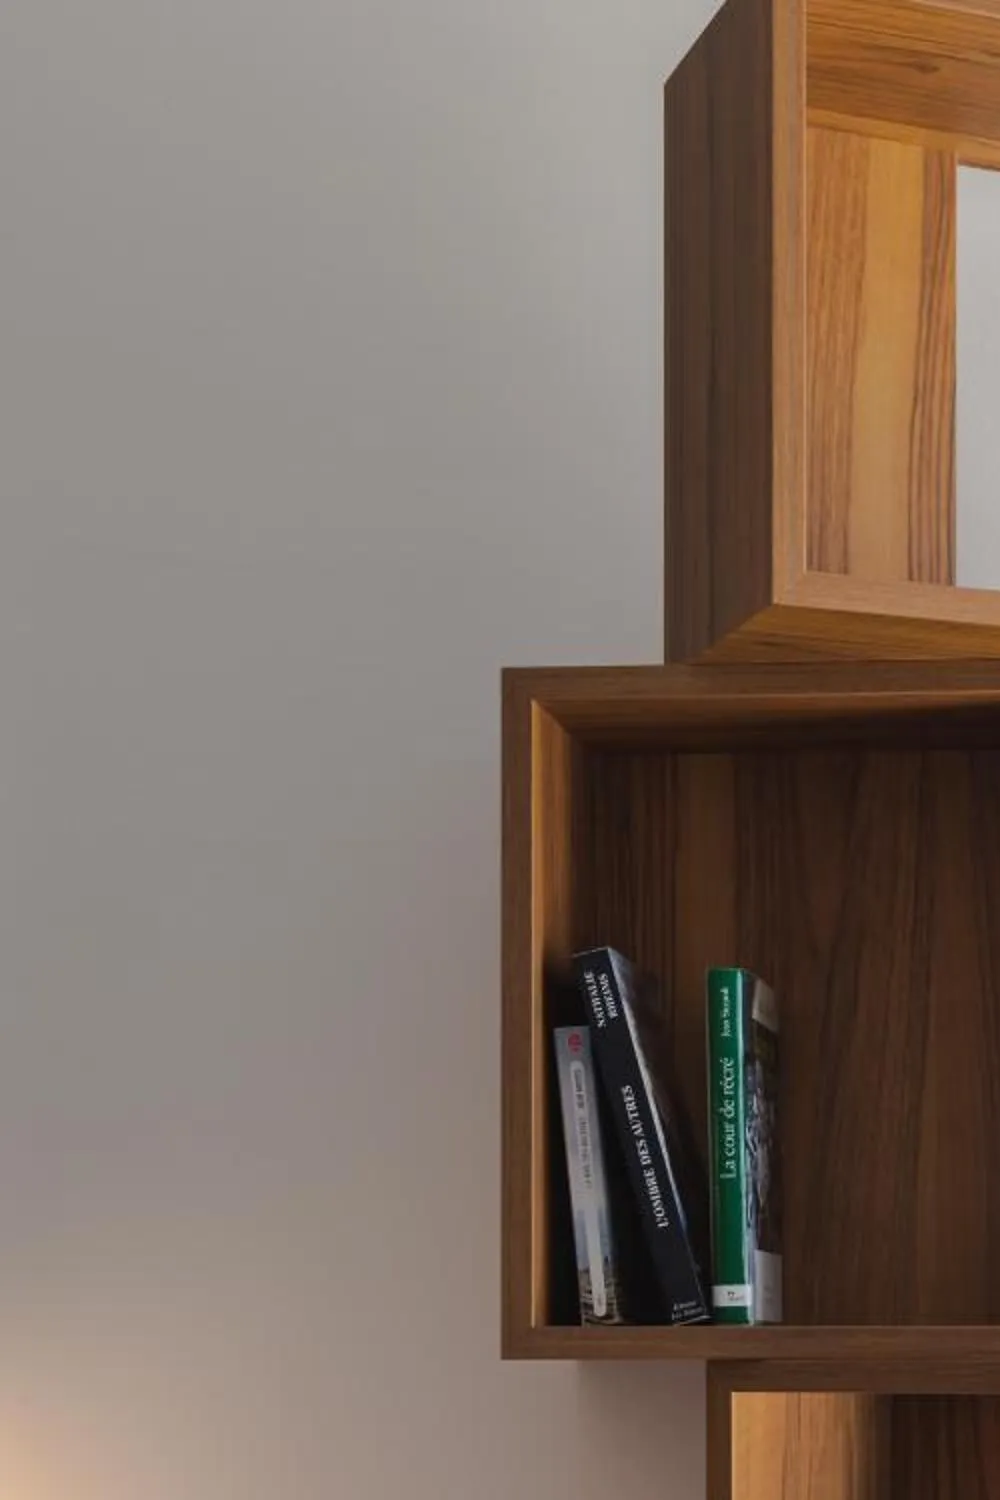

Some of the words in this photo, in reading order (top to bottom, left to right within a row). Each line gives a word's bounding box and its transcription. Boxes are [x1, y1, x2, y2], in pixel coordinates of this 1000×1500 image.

[583, 970, 606, 1028] NATHALIE
[719, 1057, 735, 1094] récré
[621, 1084, 644, 1137] AUTRES
[719, 1098, 735, 1119] de
[637, 1139, 651, 1166] DES
[724, 1121, 736, 1156] cour
[720, 1159, 736, 1178] La
[643, 1167, 669, 1229] L'OMBRE
